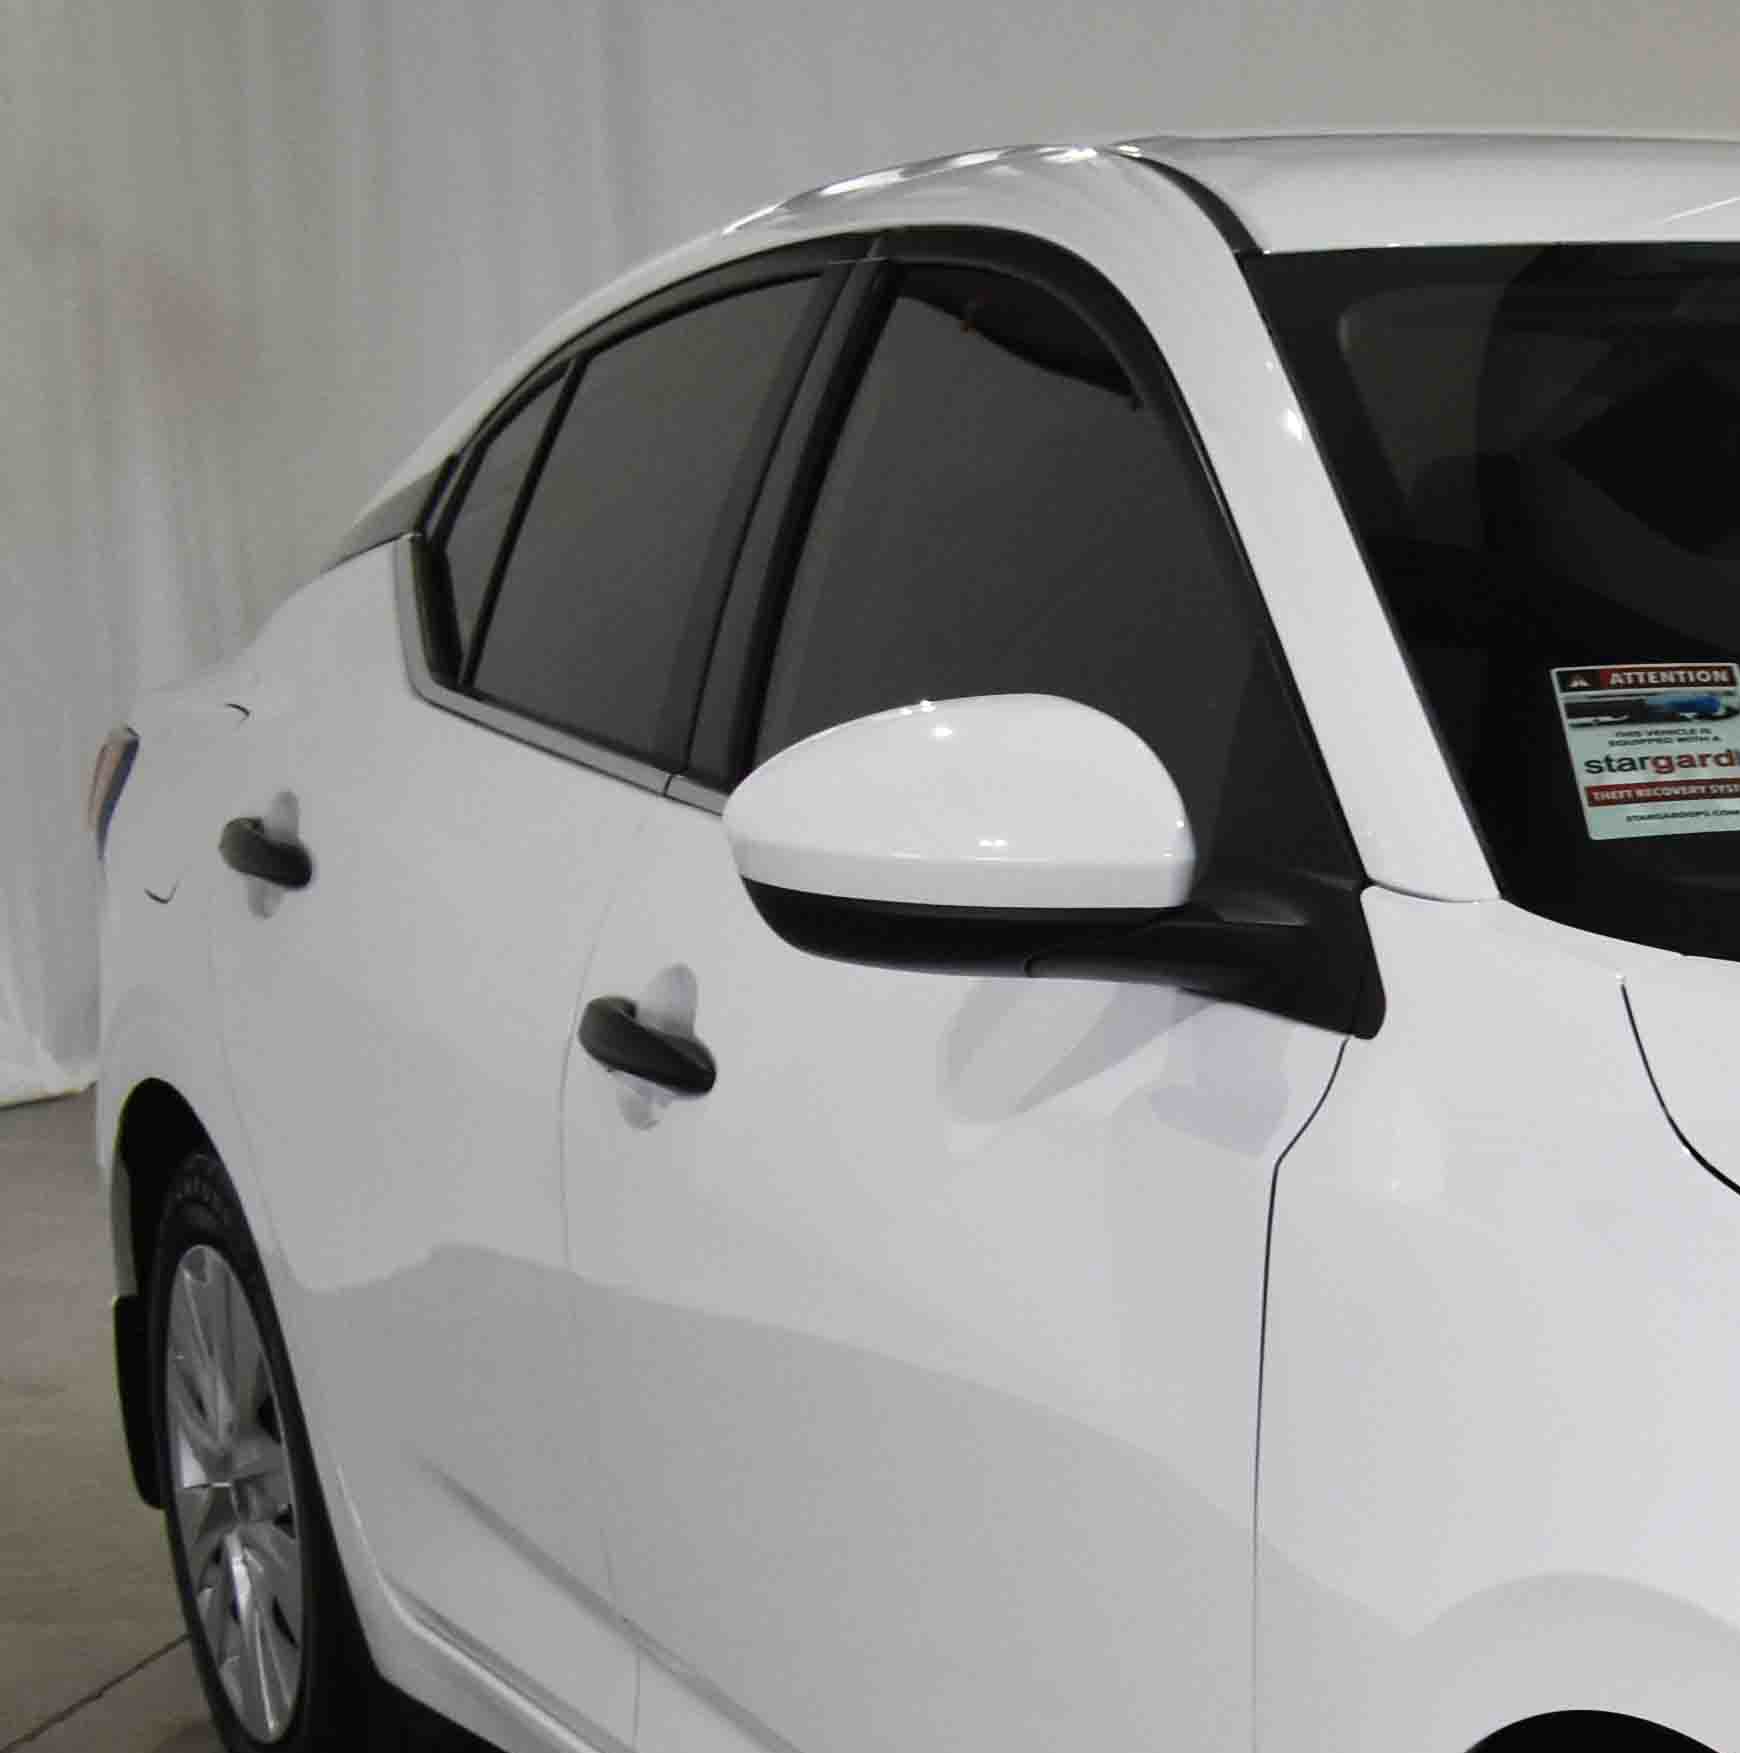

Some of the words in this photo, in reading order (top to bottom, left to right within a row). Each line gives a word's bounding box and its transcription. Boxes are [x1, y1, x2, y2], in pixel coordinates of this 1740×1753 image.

[1609, 669, 1729, 685] ATTENTION
[1646, 729, 1697, 737] VEHICLE
[1592, 790, 1632, 801] THEFT
[1636, 786, 1705, 798] RECOVERY
